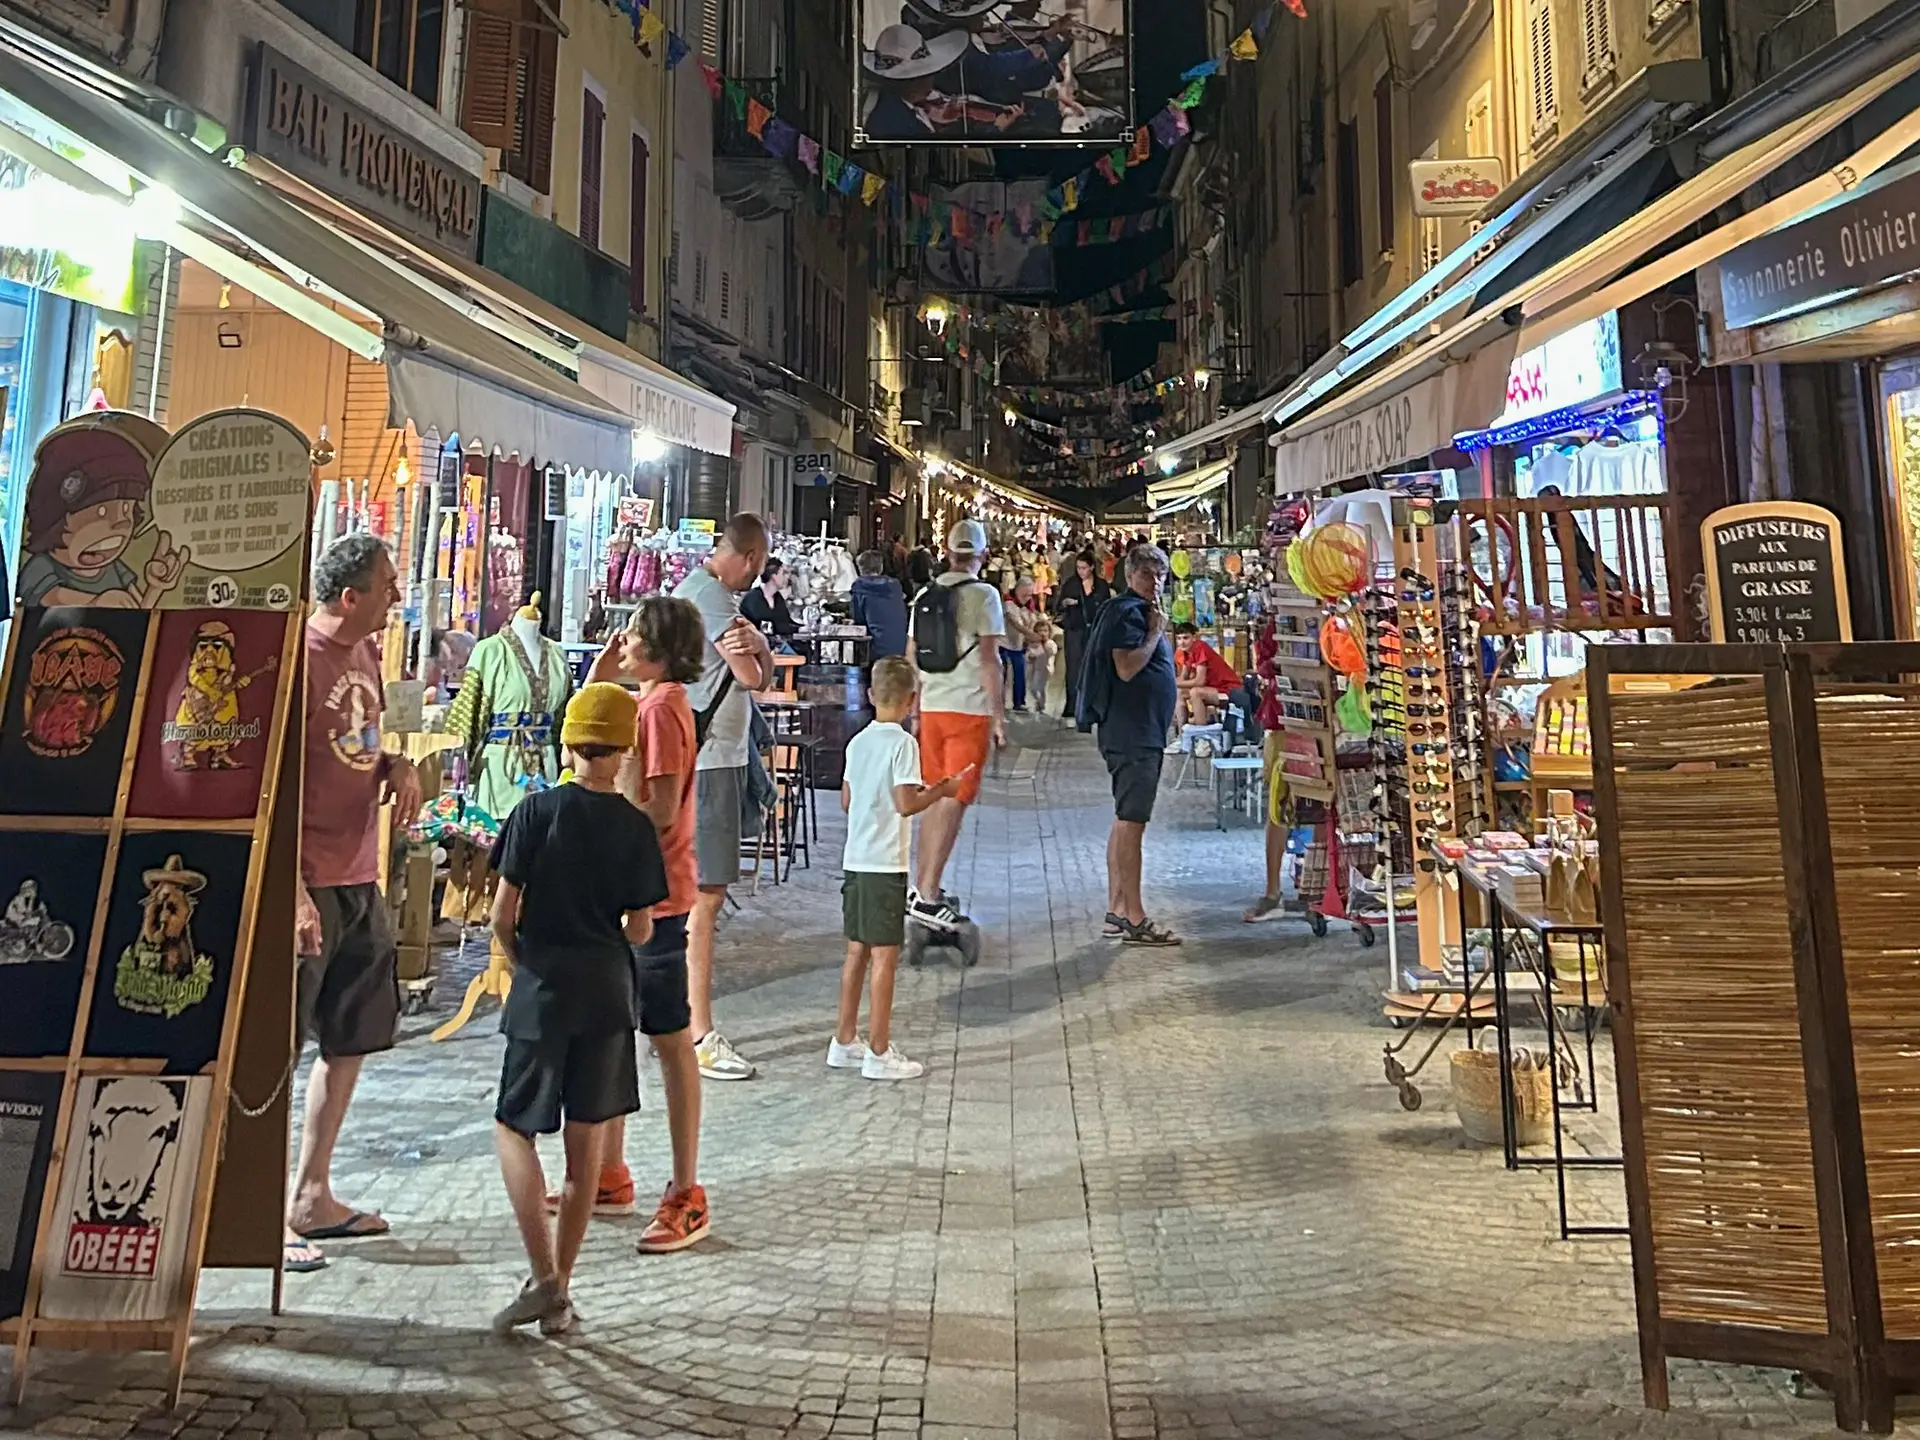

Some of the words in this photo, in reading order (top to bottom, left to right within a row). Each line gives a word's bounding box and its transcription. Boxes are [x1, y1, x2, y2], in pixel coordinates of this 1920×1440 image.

[268, 68, 329, 161] BAR
[341, 112, 475, 238] PROVENÇAL
[1727, 241, 1825, 307] Savonnerie
[1840, 210, 1917, 268] Olivier
[188, 424, 275, 452] CRÉATIONS
[1376, 396, 1412, 466] SOAP
[180, 452, 270, 480] ORIGINALES
[794, 453, 831, 473] gan
[219, 484, 233, 500] ET
[239, 476, 306, 499] FABRIQUÉES
[184, 506, 209, 524] PAR
[214, 503, 240, 521] MES
[1716, 521, 1827, 545] DIFFUSEURS
[1758, 541, 1788, 553] AUX
[1731, 561, 1797, 574] PARFUMS
[1798, 559, 1818, 572] DE
[1740, 580, 1813, 597] GRASSE
[1795, 625, 1805, 642] 3
[67, 1226, 157, 1273] OBÉÉÉ
